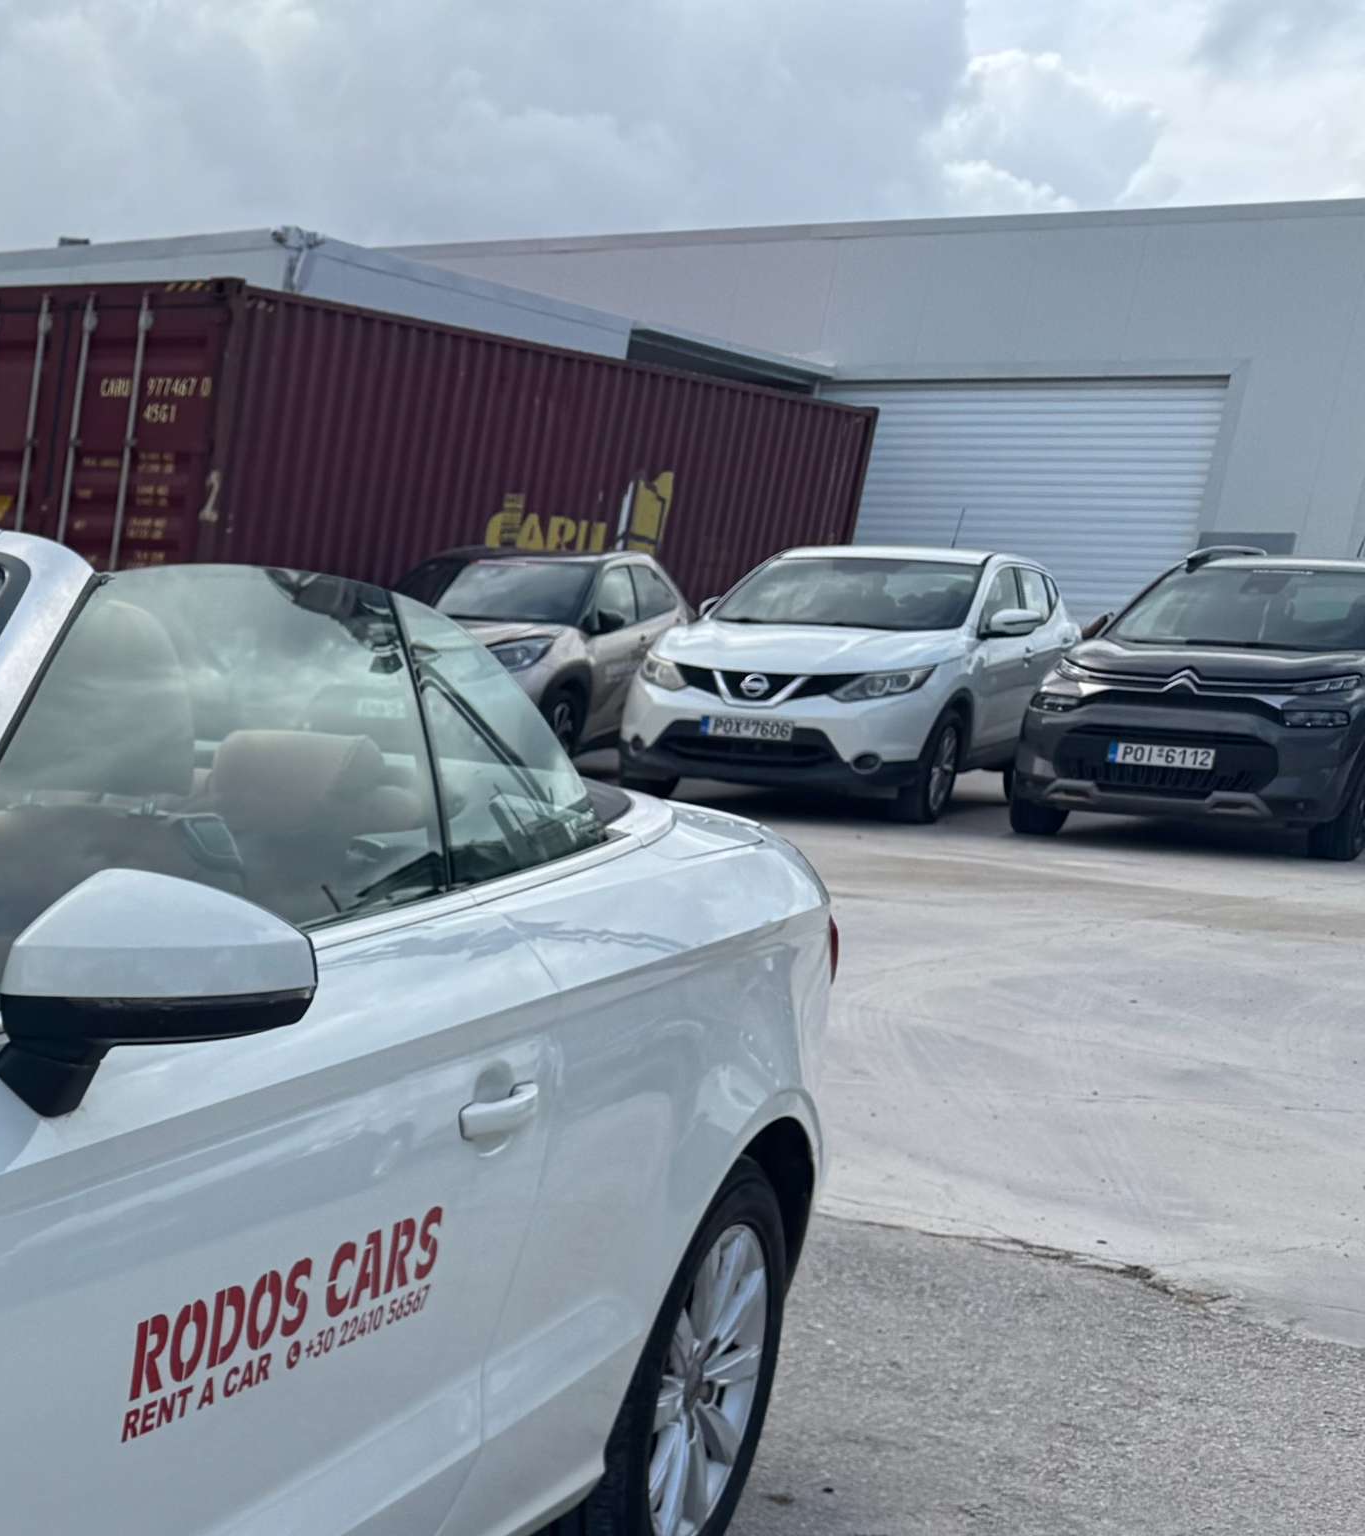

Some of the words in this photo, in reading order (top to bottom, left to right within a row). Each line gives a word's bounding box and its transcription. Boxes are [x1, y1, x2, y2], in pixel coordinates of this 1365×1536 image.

[147, 376, 198, 397] 977467
[121, 1385, 193, 1443] RENT
[197, 1376, 214, 1410] A
[223, 1353, 272, 1398] CAR
[305, 1326, 335, 1359] +30
[336, 1305, 384, 1349] 22410
[386, 1284, 431, 1326] 56567
[129, 1257, 313, 1402] RODOS
[325, 1206, 443, 1318] CARS
